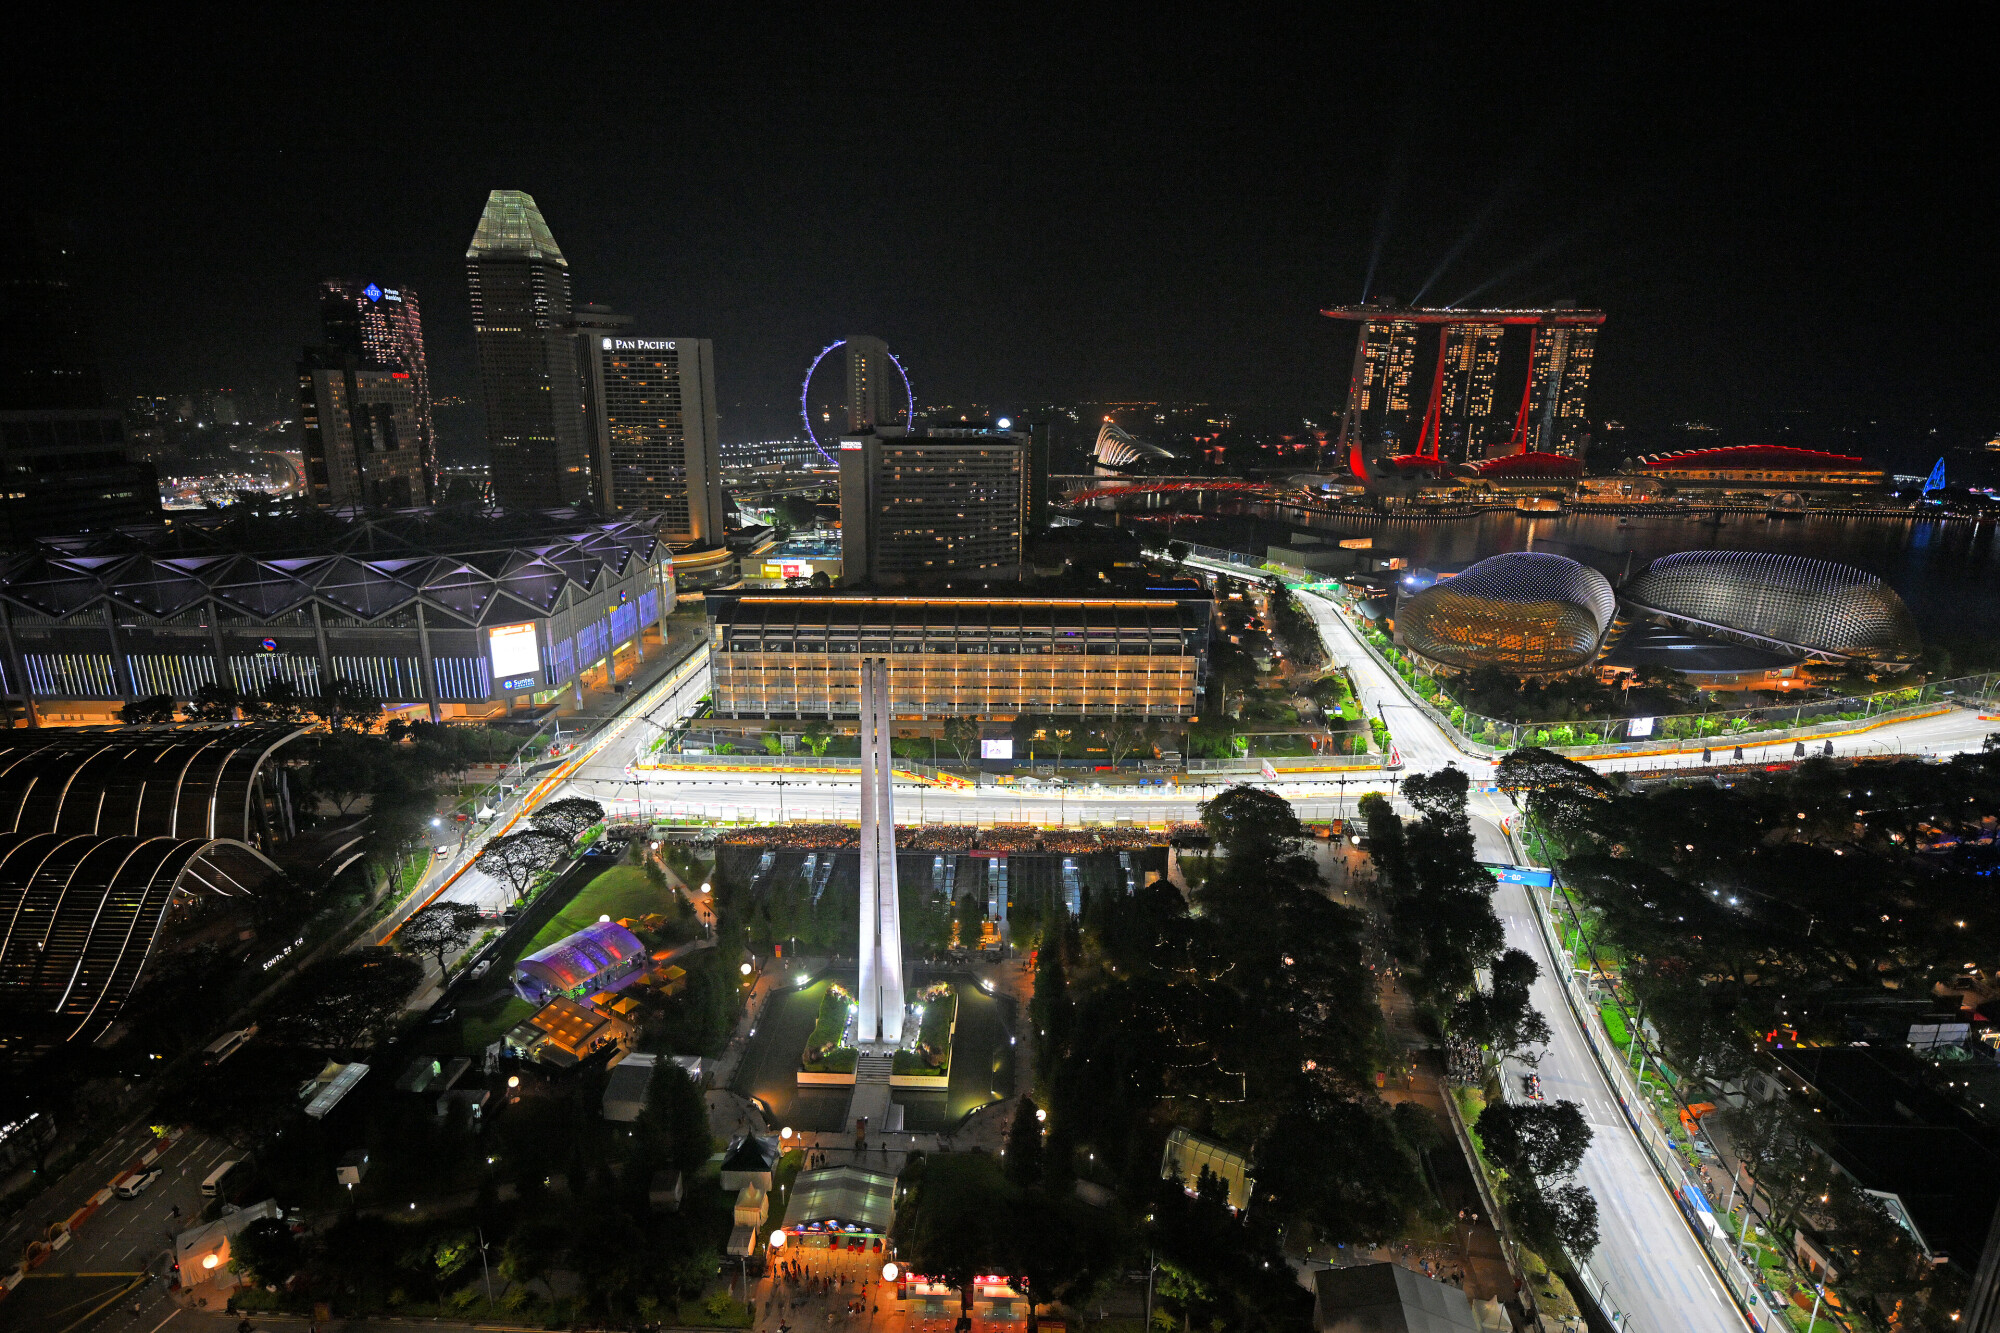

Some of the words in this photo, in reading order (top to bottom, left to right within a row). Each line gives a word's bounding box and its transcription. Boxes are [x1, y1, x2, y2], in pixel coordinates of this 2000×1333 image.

[367, 289, 381, 297] LGT
[615, 339, 636, 349] PAN
[637, 339, 676, 350] PACIFIC
